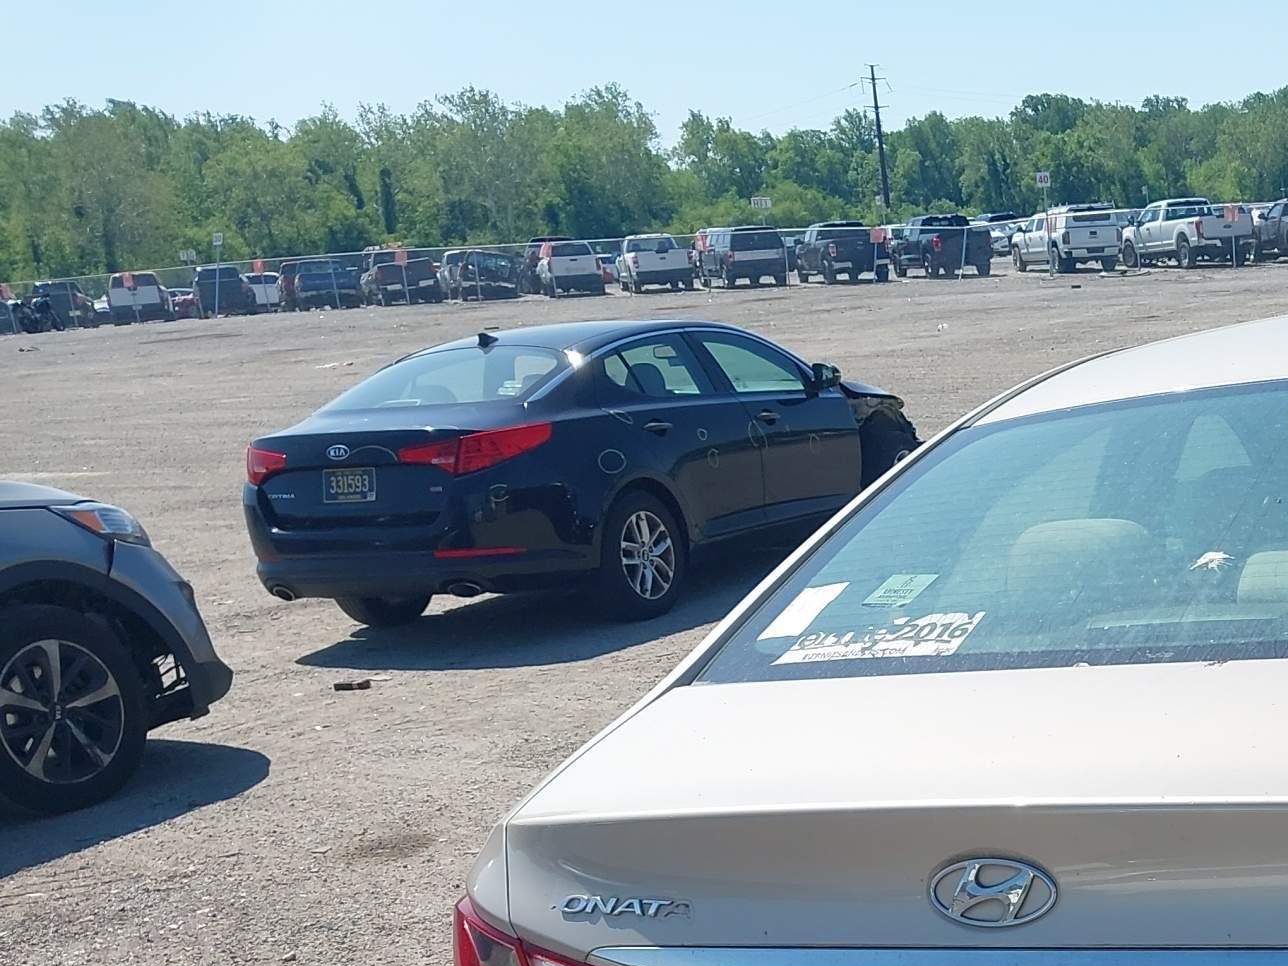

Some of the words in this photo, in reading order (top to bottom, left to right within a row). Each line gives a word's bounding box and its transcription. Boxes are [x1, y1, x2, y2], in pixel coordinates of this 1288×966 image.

[1037, 175, 1049, 184] 40
[329, 474, 370, 494] 331593
[892, 621, 974, 645] 2016
